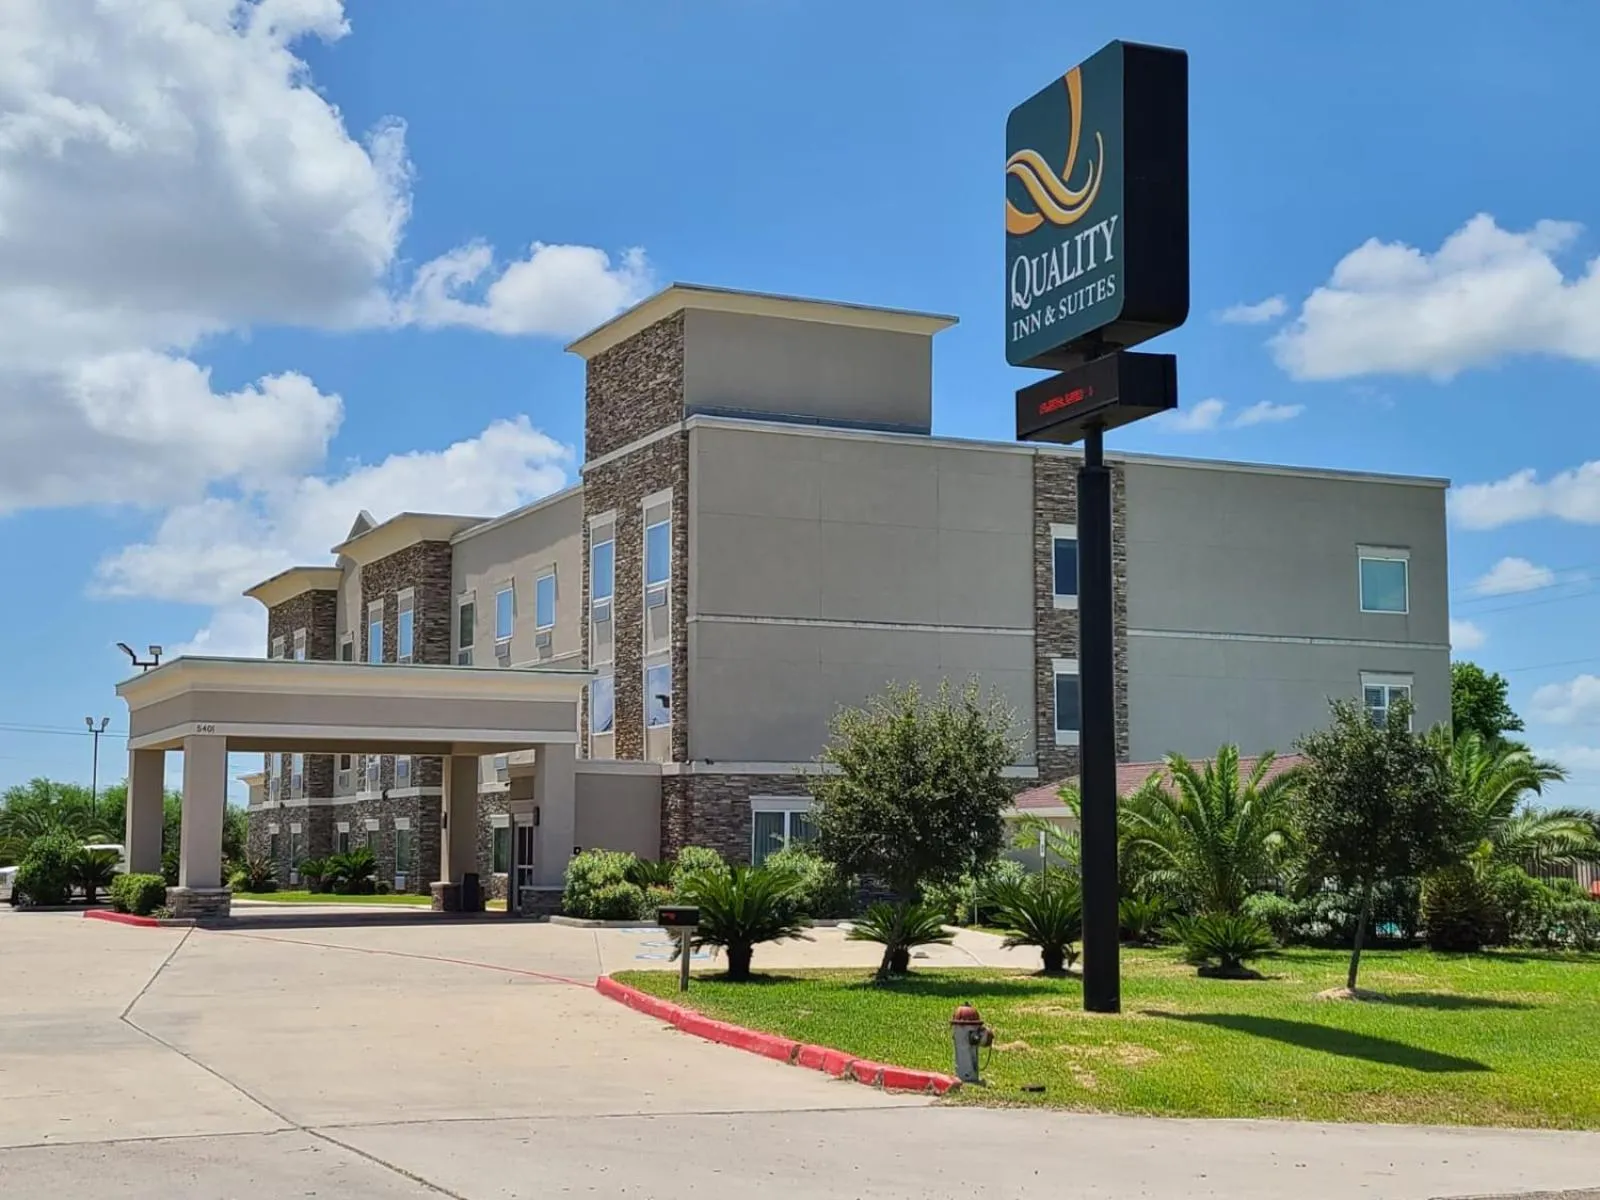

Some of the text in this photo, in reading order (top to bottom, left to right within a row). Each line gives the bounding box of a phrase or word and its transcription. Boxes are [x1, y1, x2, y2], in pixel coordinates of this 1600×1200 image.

[1011, 214, 1118, 310] QUALITY
[1012, 274, 1116, 342] INN & SUITES
[196, 723, 216, 734] 5401
